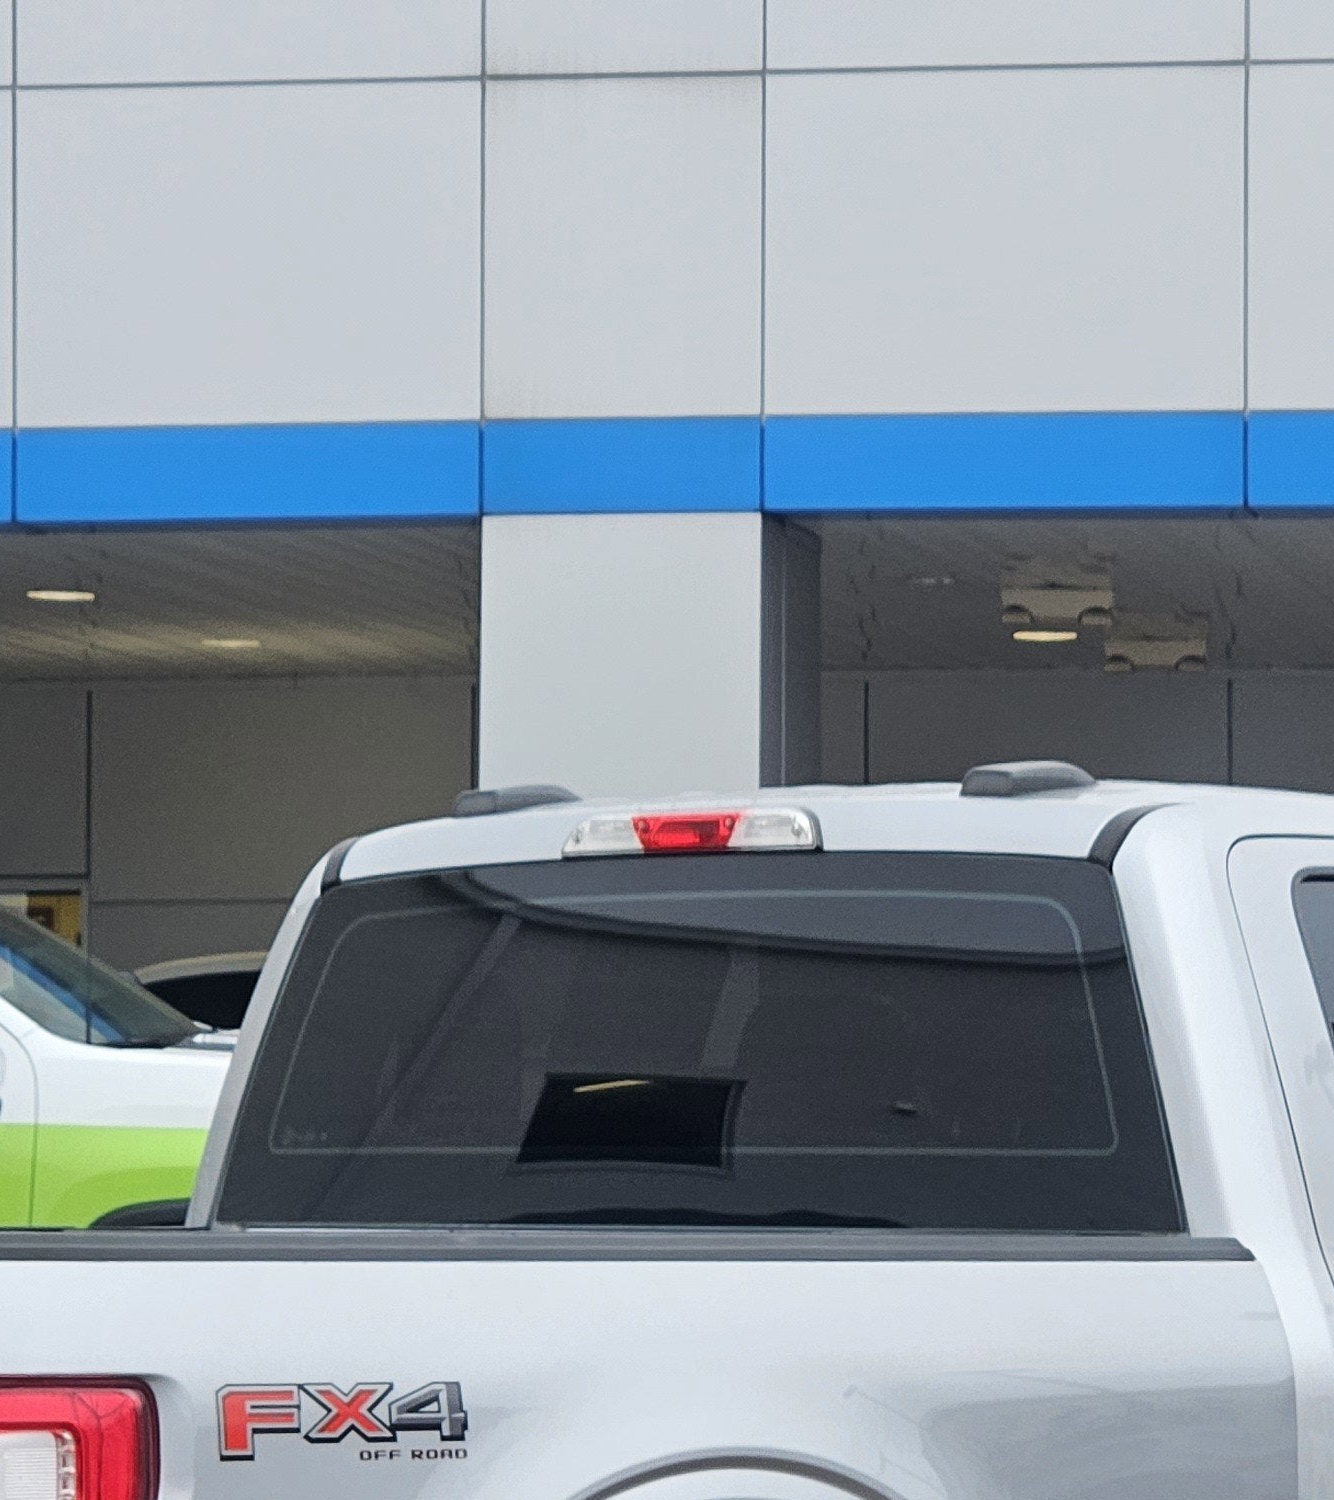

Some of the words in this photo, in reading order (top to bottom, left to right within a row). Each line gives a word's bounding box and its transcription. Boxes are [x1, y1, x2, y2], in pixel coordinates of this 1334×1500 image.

[216, 1382, 468, 1461] FX4
[359, 1449, 402, 1461] OFF
[410, 1448, 468, 1460] ROAD
